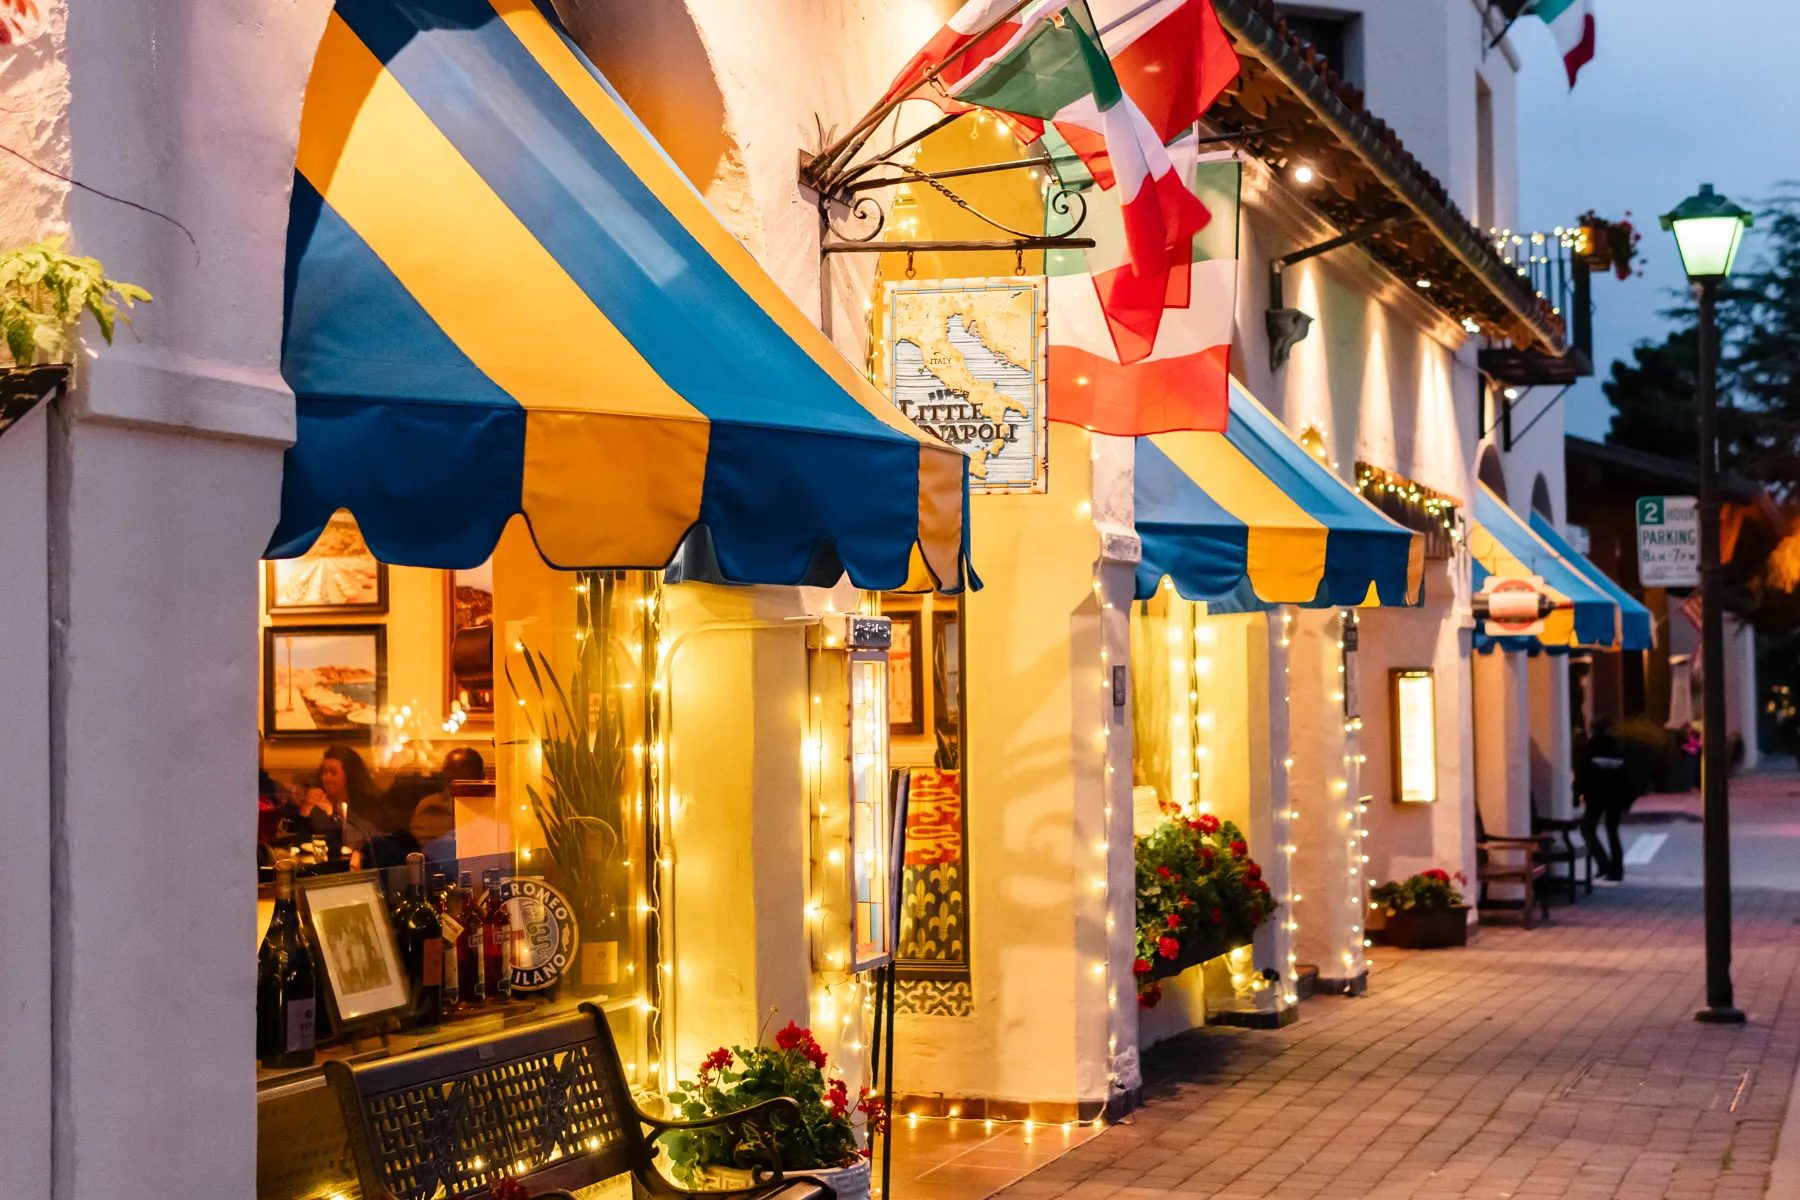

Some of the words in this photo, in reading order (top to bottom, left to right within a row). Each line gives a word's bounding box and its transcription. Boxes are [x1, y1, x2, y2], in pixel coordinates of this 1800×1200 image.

[899, 399, 984, 423] LITTLE
[1644, 502, 1658, 522] 2
[1666, 508, 1696, 520] HOUR
[1643, 530, 1696, 545] PARKING
